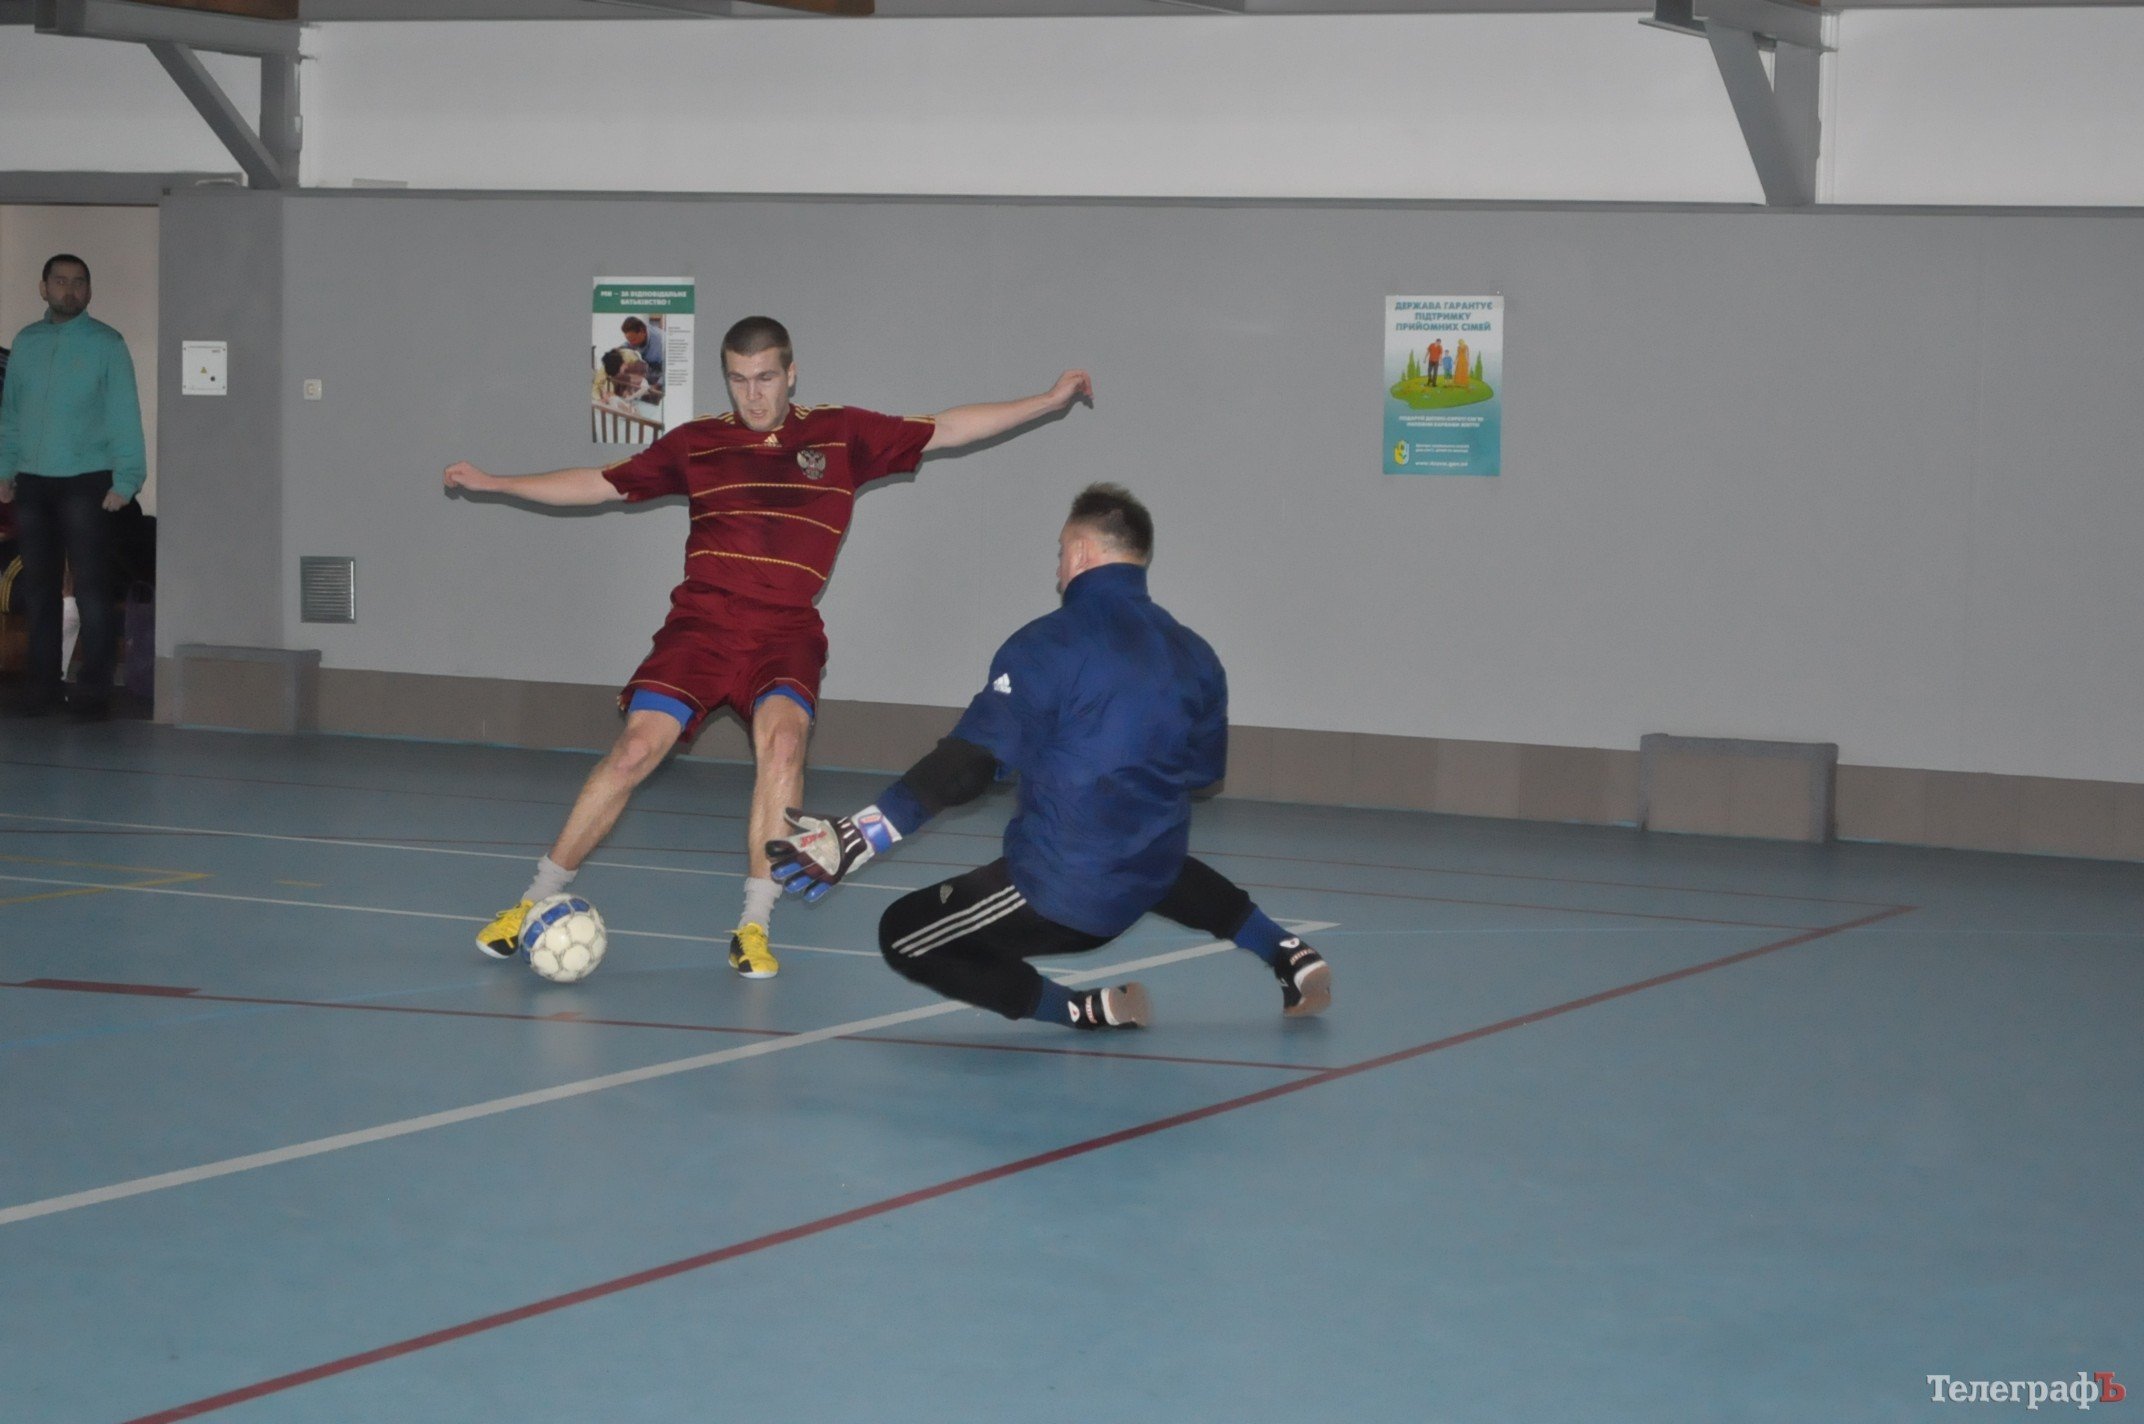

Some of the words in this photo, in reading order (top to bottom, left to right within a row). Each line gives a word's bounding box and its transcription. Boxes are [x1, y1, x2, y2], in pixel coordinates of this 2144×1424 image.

[1395, 302, 1441, 310] ДЕРЖАВА
[1444, 302, 1493, 310] ГАРАНТУЄ
[1415, 312, 1472, 321] ПІДТРИМКУ
[1395, 322, 1459, 331] ПРИЙОМНИХ
[1461, 322, 1492, 331] СІМЕЙ
